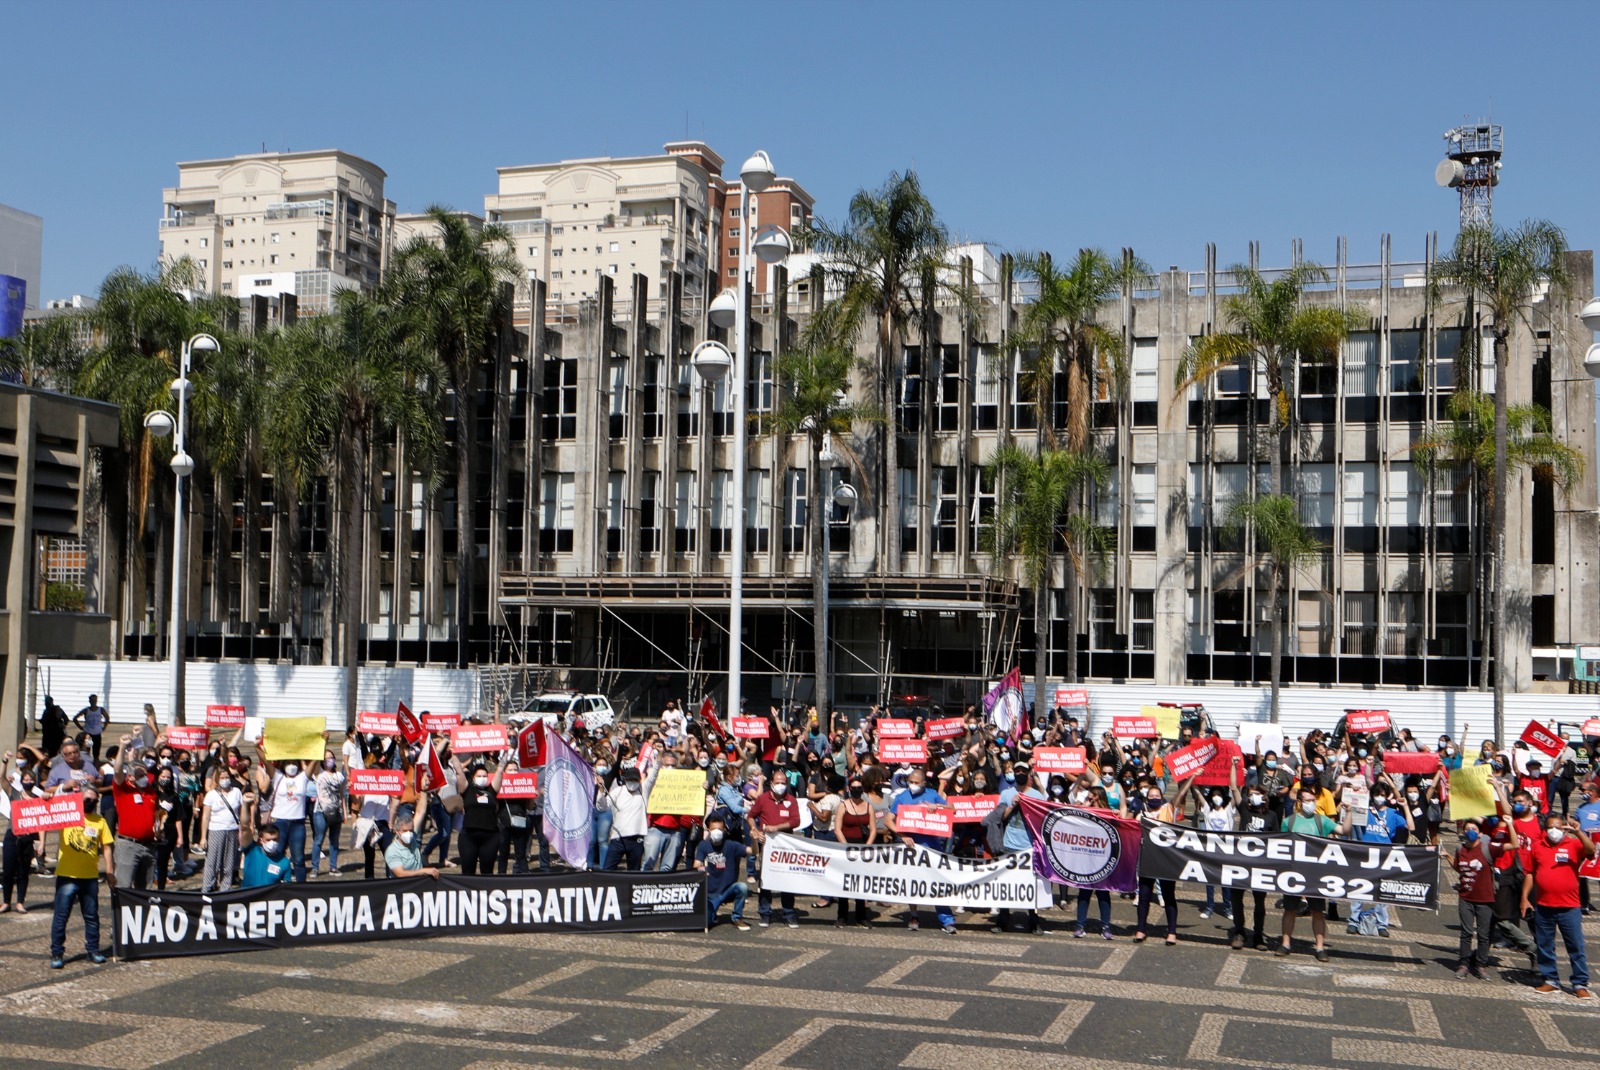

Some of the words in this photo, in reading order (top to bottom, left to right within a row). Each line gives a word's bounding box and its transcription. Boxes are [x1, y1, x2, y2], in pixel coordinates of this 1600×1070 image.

[472, 738, 504, 747] BOLSONARO
[528, 731, 538, 754] CUT
[369, 783, 401, 791] BOLSONARO
[20, 805, 49, 817] VACINA,
[50, 801, 76, 813] AUXÍLIO
[925, 813, 947, 822] AUXÍLIO
[18, 817, 38, 828] FORA
[39, 812, 80, 825] BOLSONARO
[916, 820, 949, 831] BOLSONARO
[1053, 831, 1109, 848] SINDSERV
[1149, 826, 1349, 866] CANCELA
[1360, 845, 1414, 872] JÁ
[770, 851, 830, 867] SINDSERV
[846, 846, 931, 868] CONTRA
[938, 854, 951, 870] A
[1006, 853, 1030, 870] 32
[1076, 857, 1116, 882] VALORIZAÇÃO
[843, 874, 860, 893] EM
[864, 876, 907, 896] DEFESA
[910, 881, 926, 897] DO
[930, 882, 980, 902] SERVIÇO
[984, 878, 1034, 902] PÚBLICO
[1179, 860, 1208, 883] A
[1221, 864, 1306, 894] PEC
[1317, 876, 1374, 900] 32
[632, 887, 698, 904] SINDSERV
[1380, 882, 1430, 896] SINDSERV
[121, 896, 188, 945] NÃO
[195, 895, 217, 940] À
[226, 895, 375, 940] REFORMA
[381, 886, 622, 930] ADMINISTRATIVA
